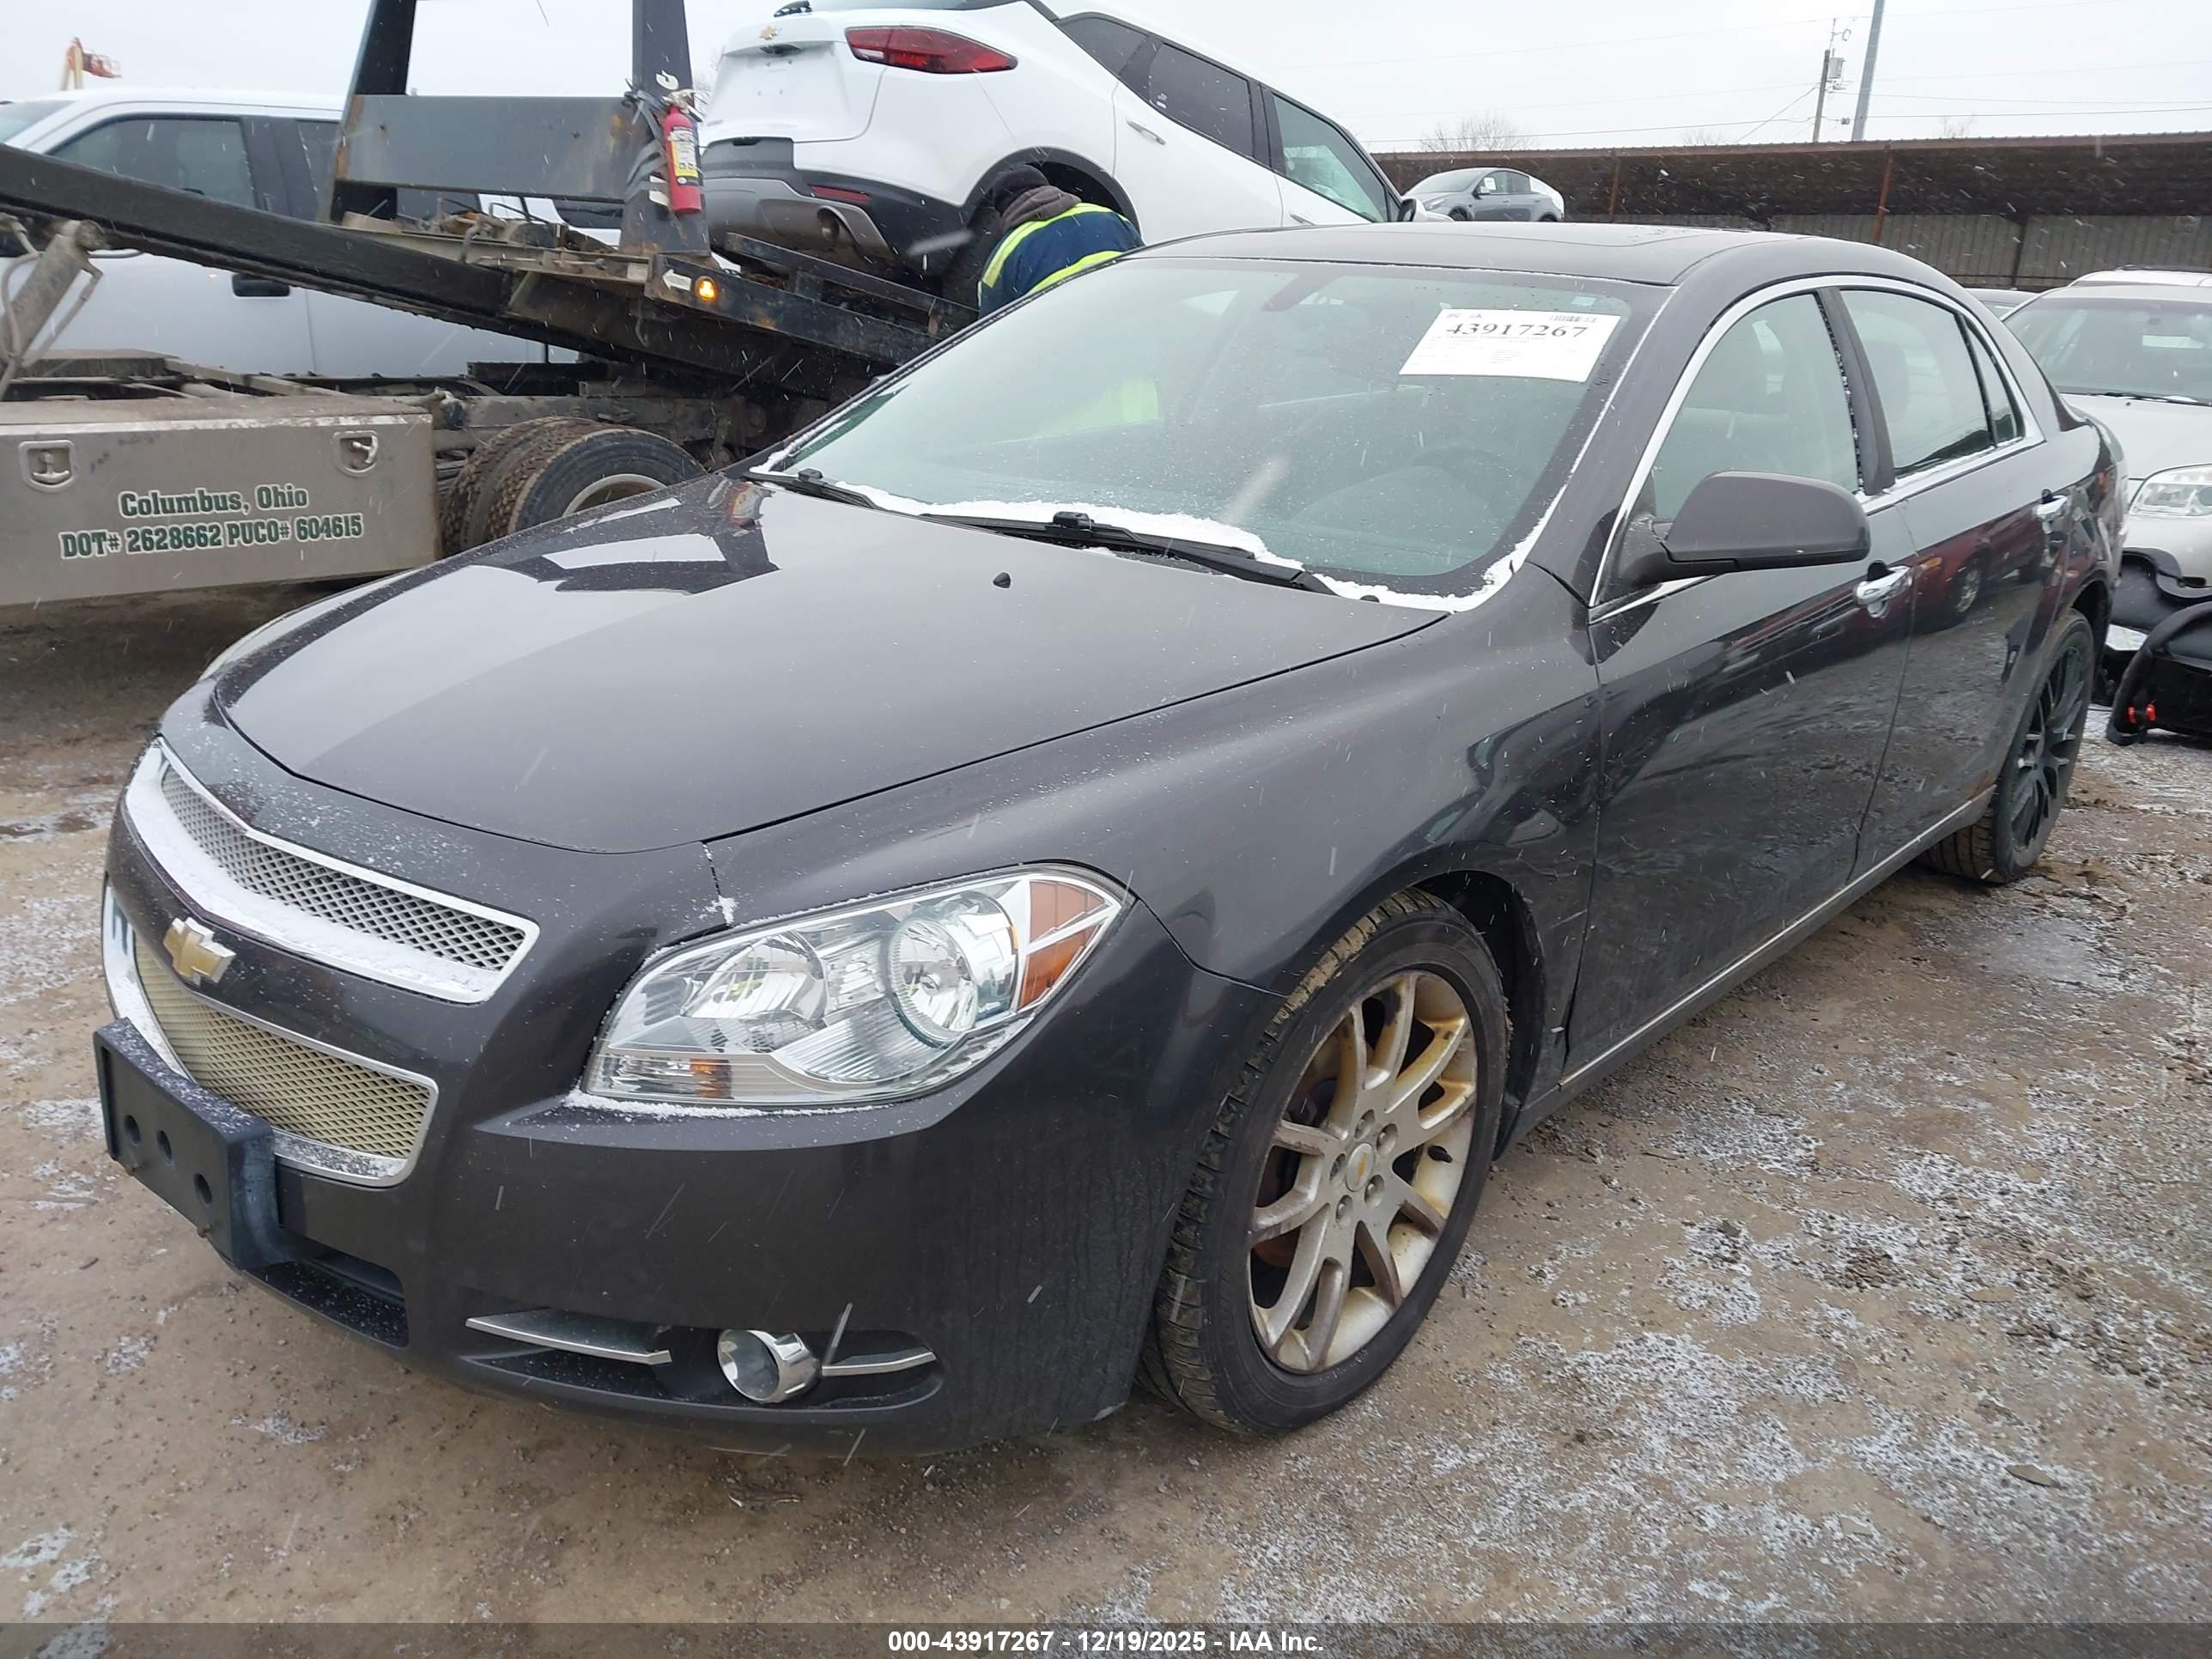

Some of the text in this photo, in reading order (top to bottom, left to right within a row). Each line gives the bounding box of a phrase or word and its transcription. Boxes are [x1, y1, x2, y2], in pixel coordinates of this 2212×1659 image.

[1446, 323, 1588, 337] 43917267
[119, 483, 308, 518] Columbus, Ohio
[60, 514, 363, 559] DOT# 2628662 PUCO# 604615
